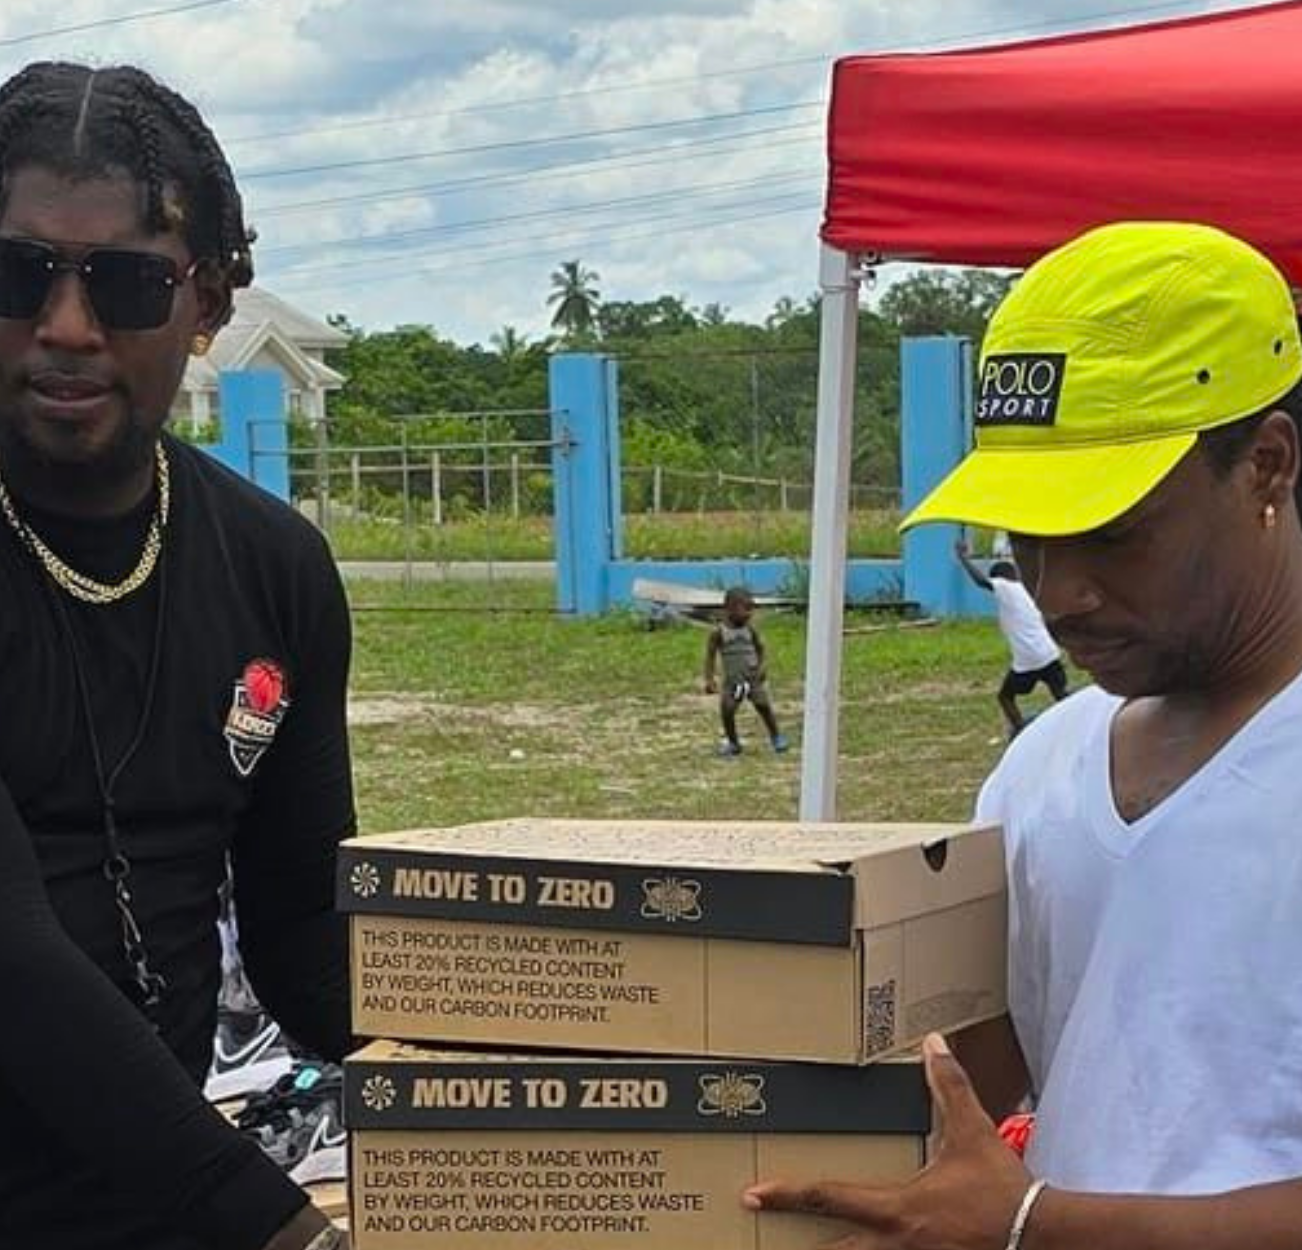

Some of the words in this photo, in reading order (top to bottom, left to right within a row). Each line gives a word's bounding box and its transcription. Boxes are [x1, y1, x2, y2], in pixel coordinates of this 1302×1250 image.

[982, 361, 1054, 397] POLO
[978, 398, 1051, 418] SPORT
[393, 868, 479, 901] MOVE
[487, 874, 526, 904] TO
[537, 877, 615, 910] ZERO
[362, 931, 398, 948] THIS
[402, 932, 481, 951] PRODUCT
[486, 935, 500, 951] IS
[503, 935, 551, 953] MADE
[555, 938, 598, 955] WITH
[601, 941, 622, 957] AT
[362, 953, 412, 971] LEAST
[415, 955, 450, 973] 20%
[455, 957, 542, 977] RECYCLED
[546, 960, 626, 980] CONTENT
[362, 974, 385, 990] BY
[388, 975, 454, 995] WEIGHT,
[457, 978, 513, 997] WHICH
[517, 981, 598, 1001] REDUCES
[599, 985, 660, 1003] WASTE
[362, 996, 397, 1013] AND
[400, 998, 436, 1016] OUR
[439, 1000, 511, 1019] CARBON
[514, 1003, 610, 1024] FOOTPRINT.
[412, 1079, 511, 1108] MOVE
[522, 1079, 567, 1108] TO
[579, 1079, 668, 1109] ZERO
[363, 1150, 404, 1166] THIS
[409, 1150, 500, 1166] PRODUCT
[505, 1150, 523, 1166] IS
[527, 1150, 581, 1166] MADE
[585, 1150, 635, 1166] WITH
[638, 1150, 662, 1166] AT
[364, 1172, 420, 1188] LEAST
[426, 1172, 466, 1188] 20%
[471, 1172, 572, 1188] RECYCLED
[575, 1172, 665, 1188] CONTENT
[364, 1194, 389, 1210] BY
[393, 1194, 471, 1212] WEIGHT,
[474, 1194, 539, 1211] WHICH
[544, 1194, 632, 1211] REDUCES
[635, 1194, 704, 1211] WASTE
[364, 1216, 405, 1232] AND
[408, 1216, 451, 1233] OUR
[455, 1216, 537, 1233] CARBON
[540, 1216, 651, 1233] FOOTPRINT.
